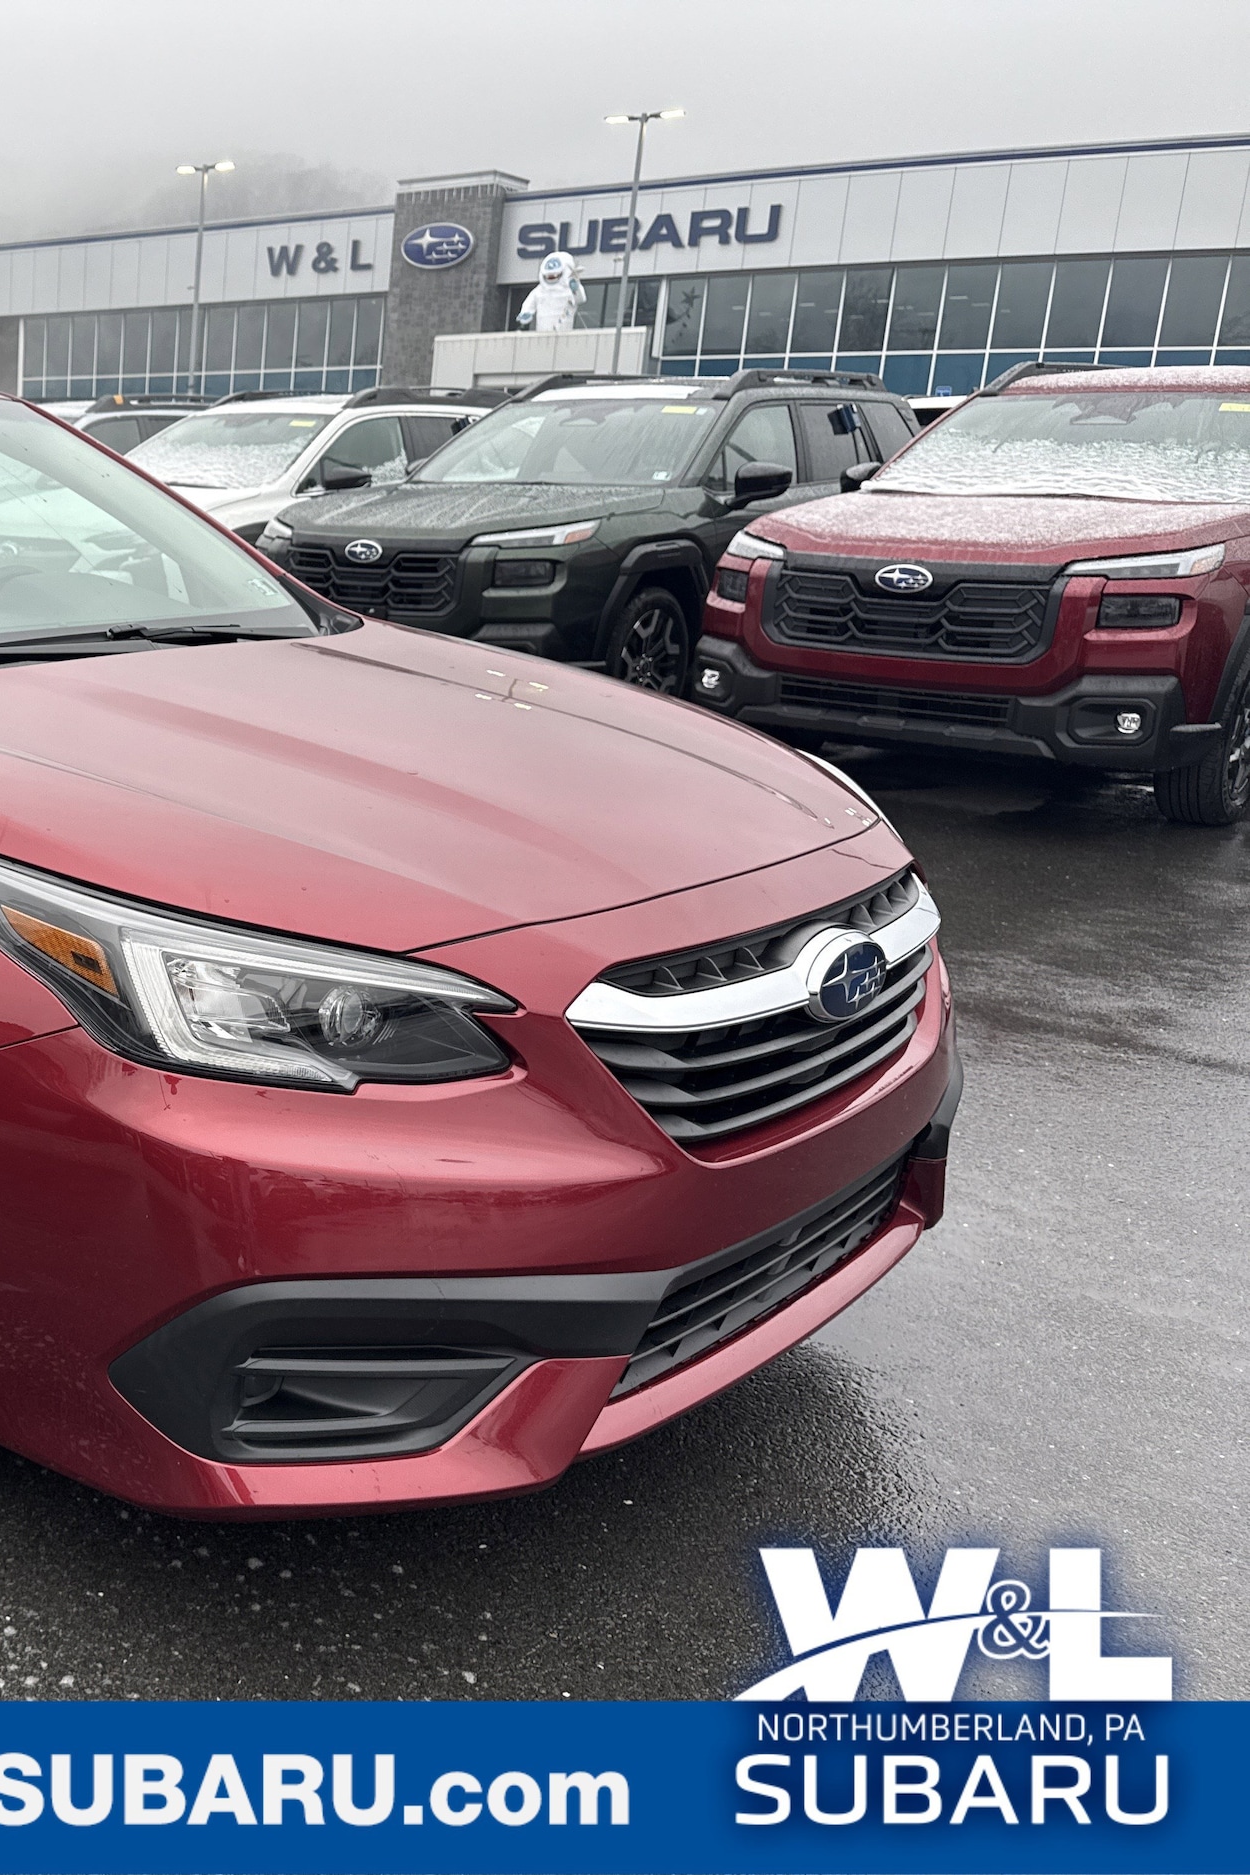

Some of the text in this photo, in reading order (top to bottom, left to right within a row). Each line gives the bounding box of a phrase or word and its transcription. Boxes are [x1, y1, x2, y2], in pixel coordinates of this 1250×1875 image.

[517, 204, 782, 260] SUBARU
[267, 240, 373, 277] W & L
